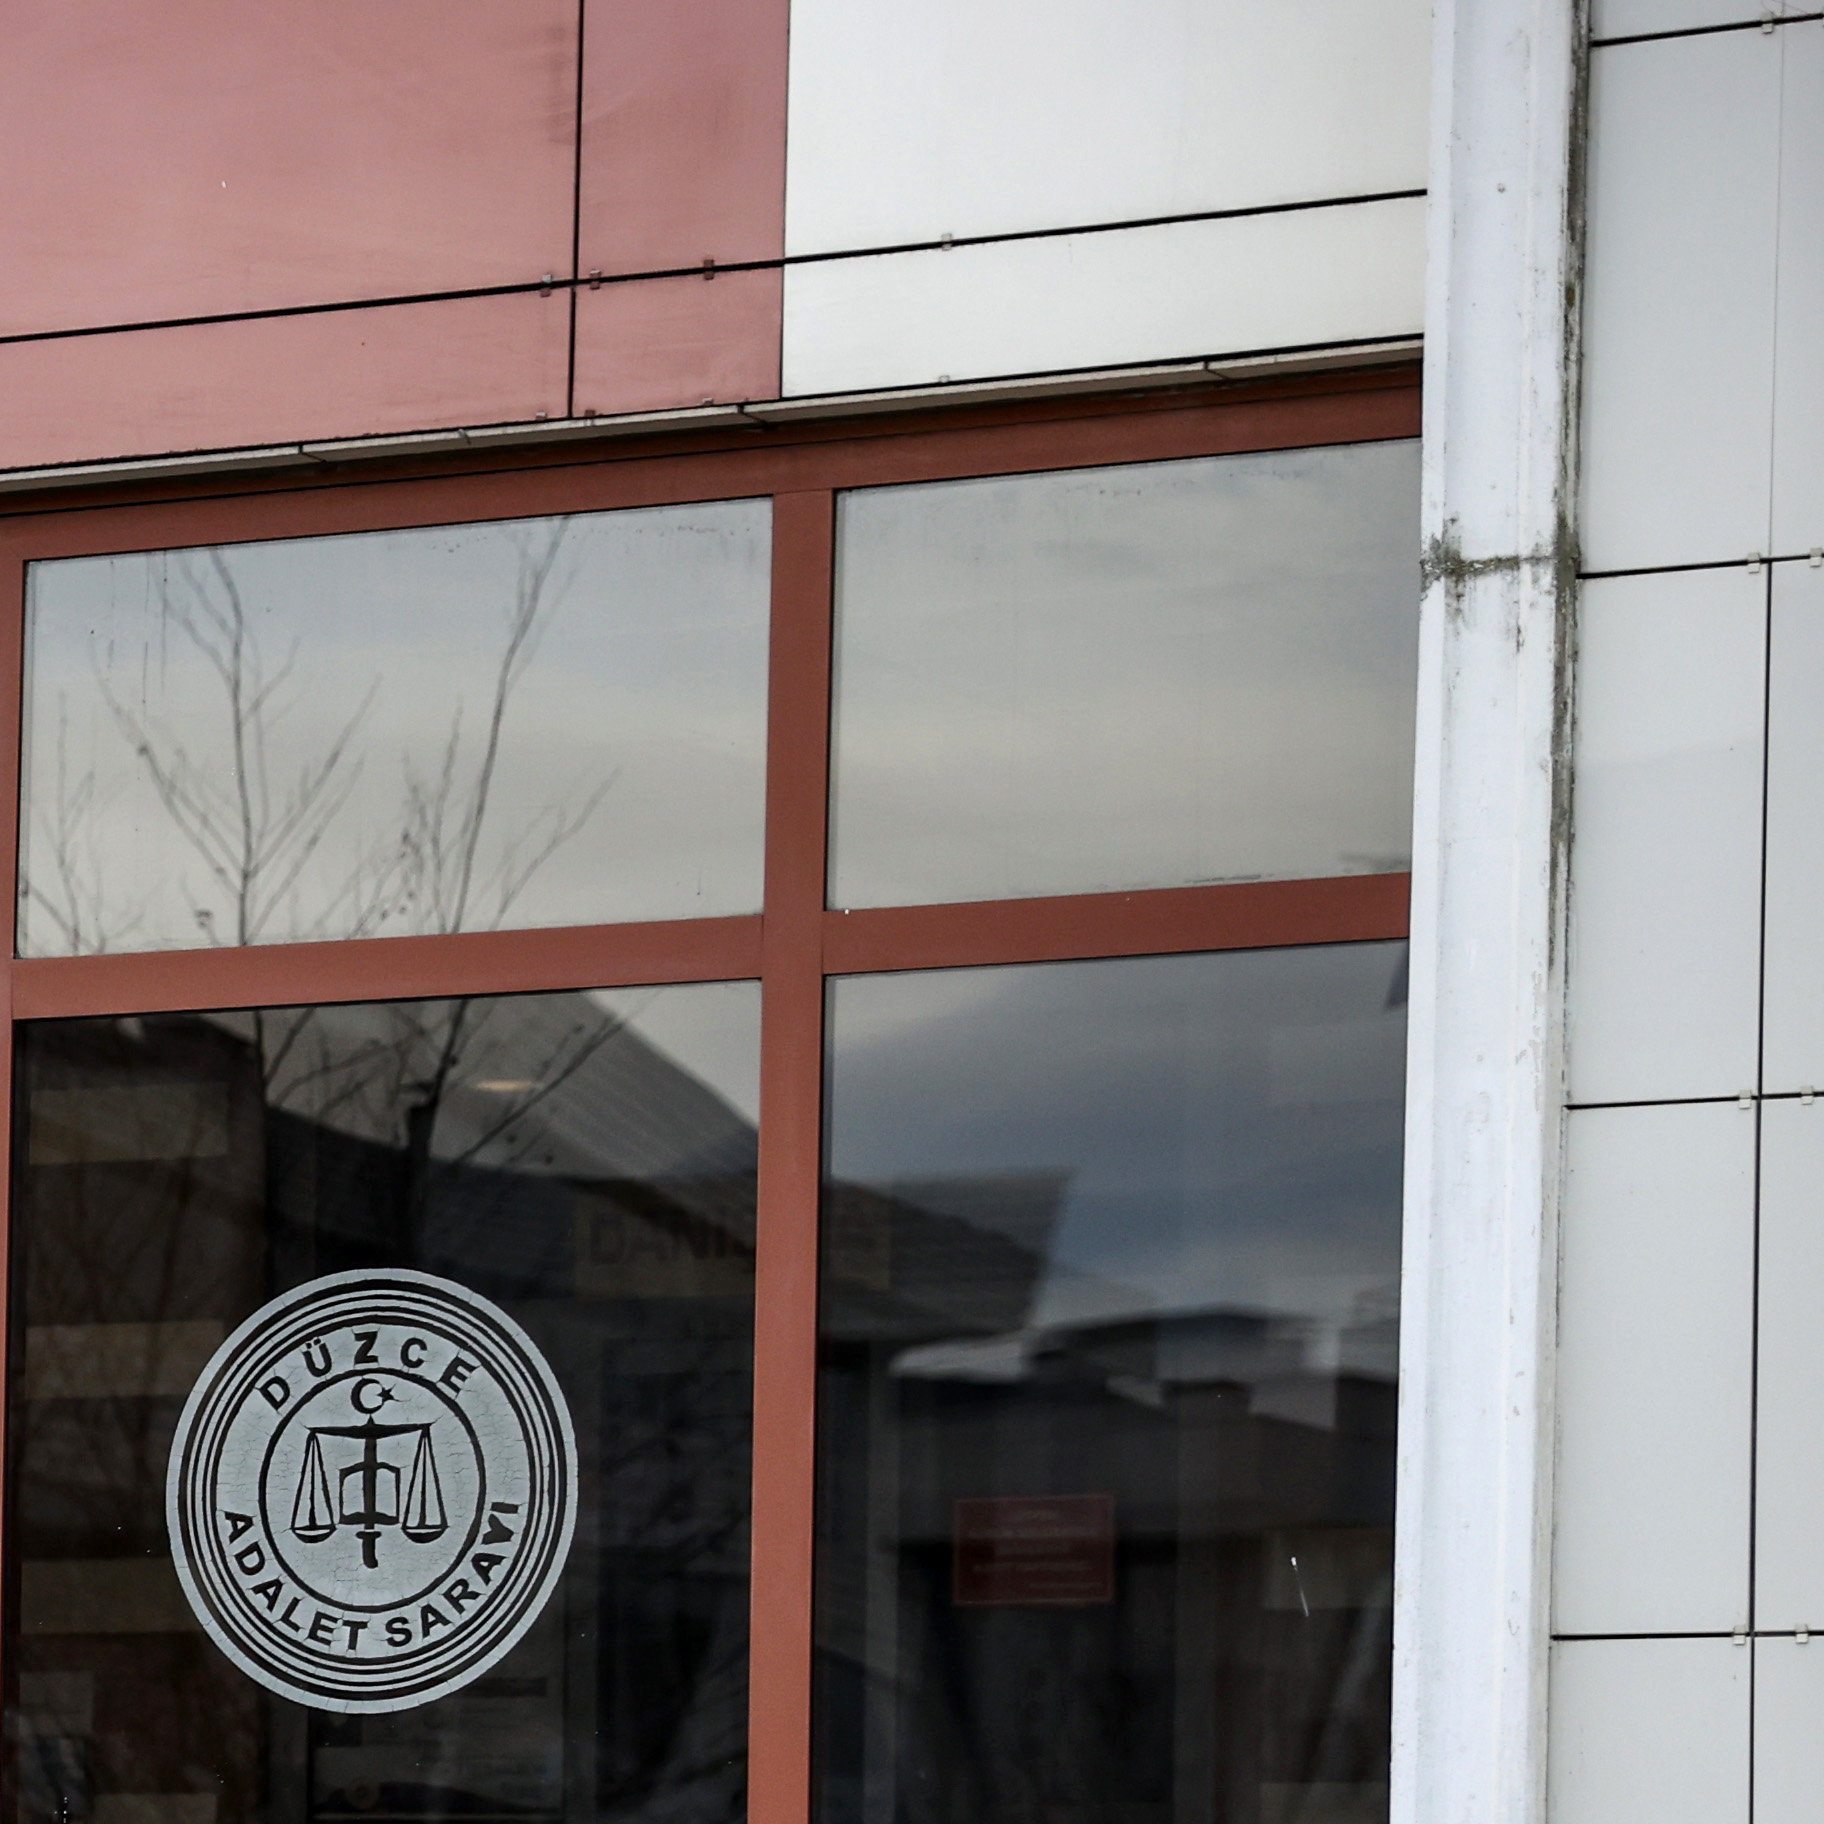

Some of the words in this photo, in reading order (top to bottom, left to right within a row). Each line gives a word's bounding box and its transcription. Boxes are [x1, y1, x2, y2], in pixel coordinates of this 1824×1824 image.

[258, 1330, 482, 1412] DÜZCE
[224, 1509, 368, 1652] ADALET
[386, 1500, 520, 1648] SARAYI
